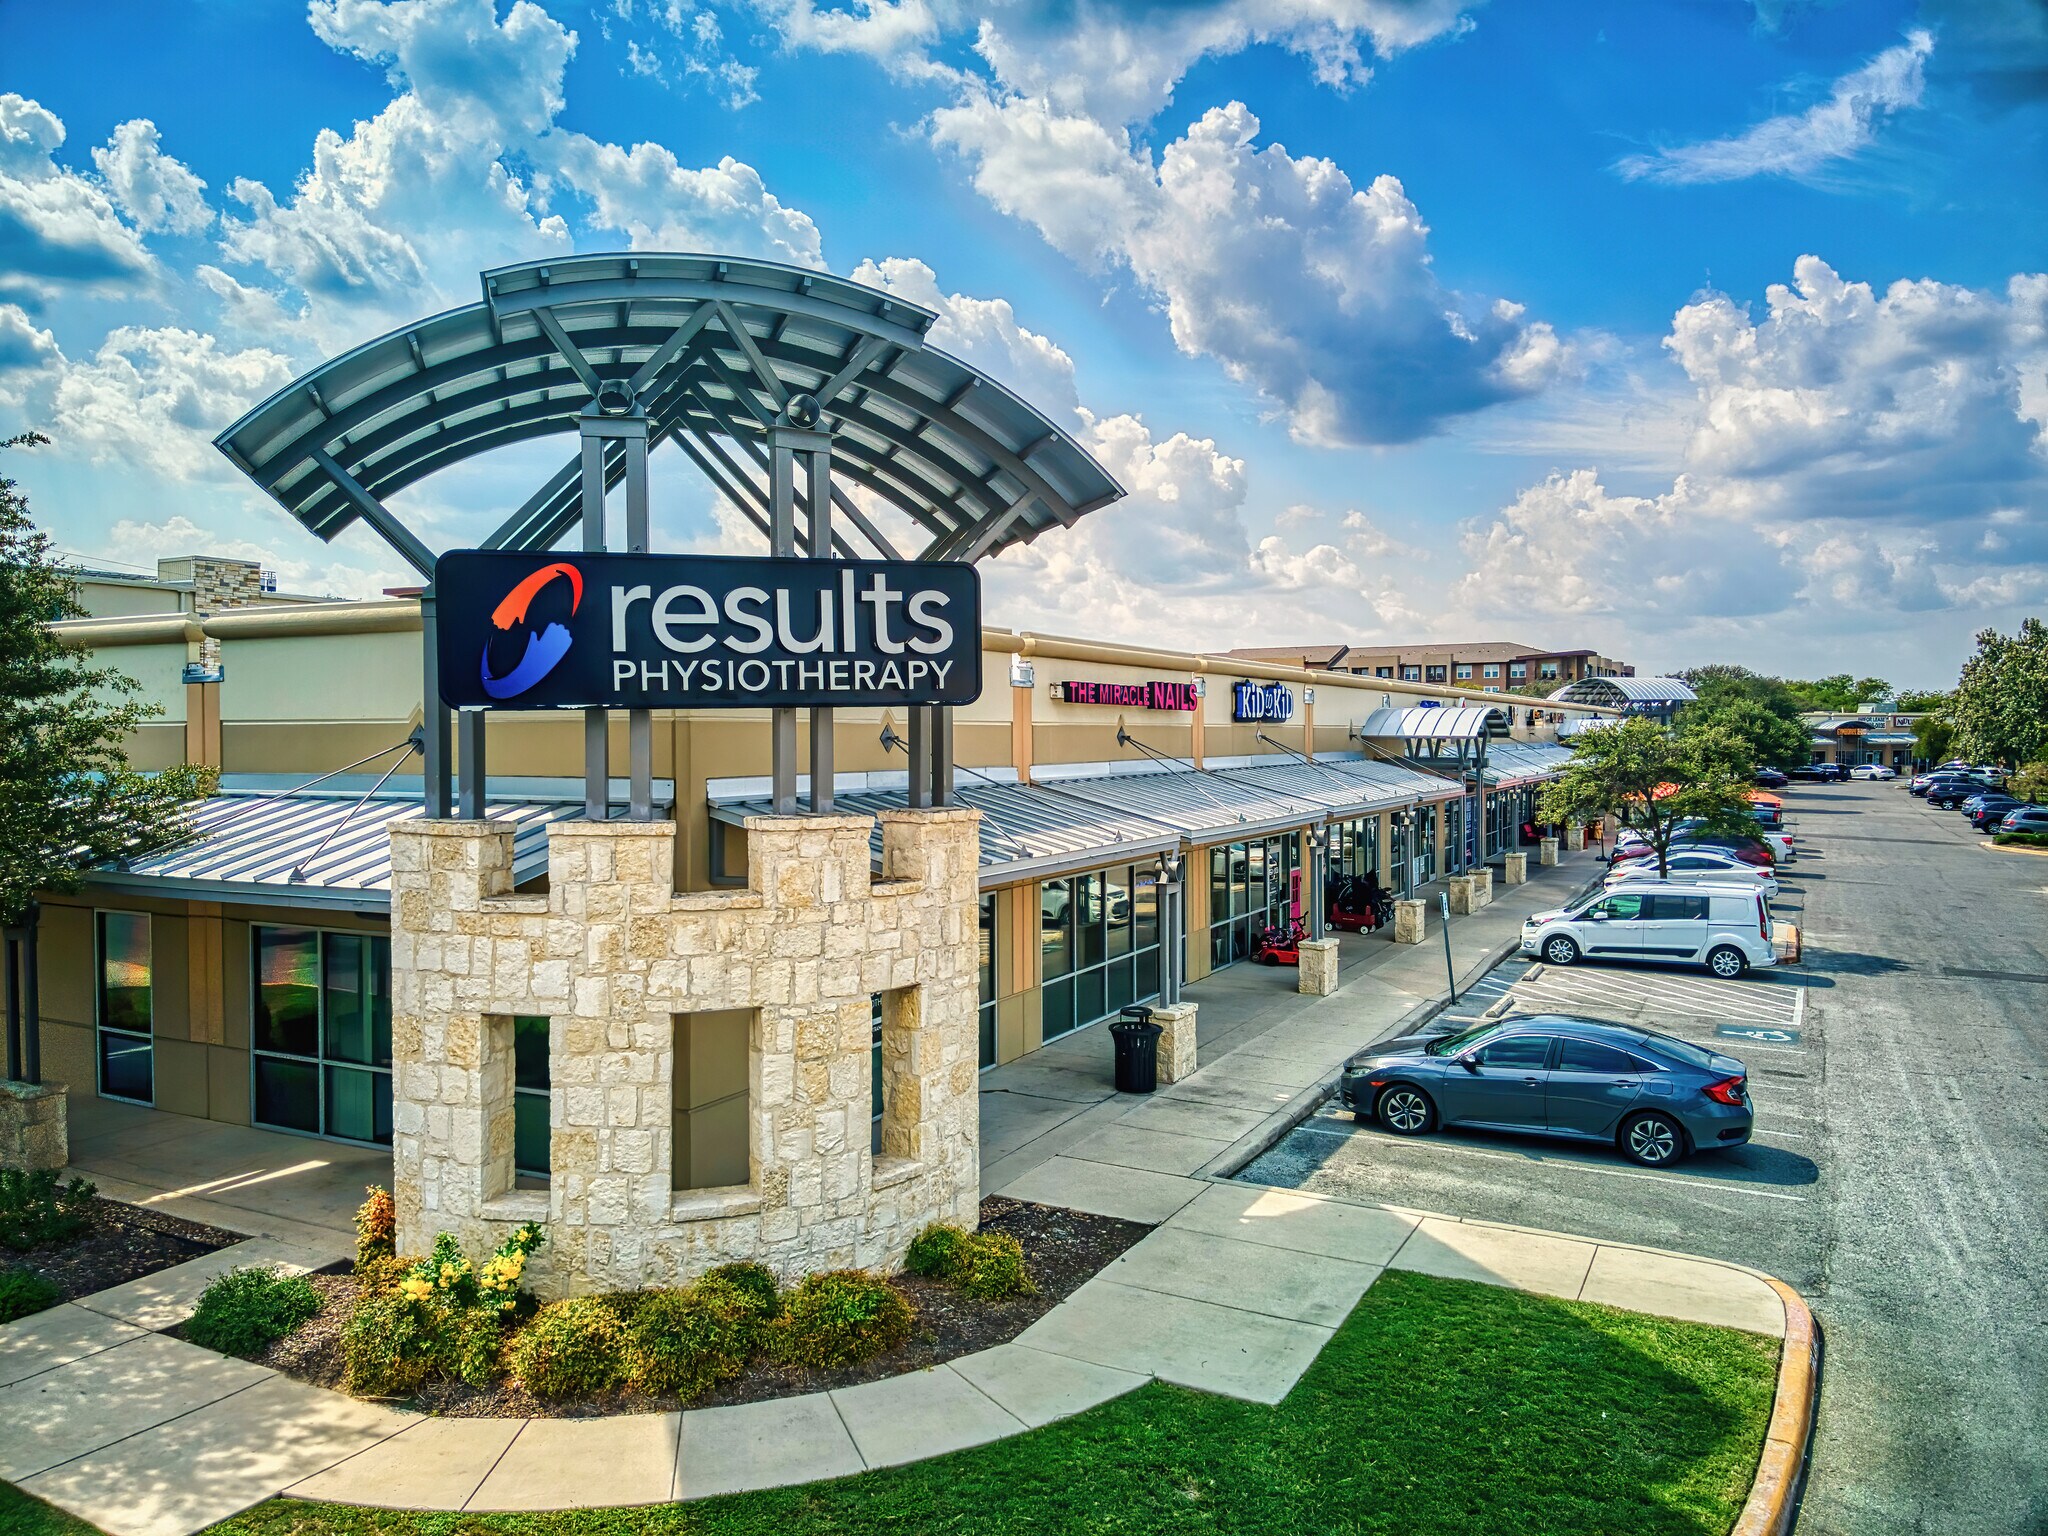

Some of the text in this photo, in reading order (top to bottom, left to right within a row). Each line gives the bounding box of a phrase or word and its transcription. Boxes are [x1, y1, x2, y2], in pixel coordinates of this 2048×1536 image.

[612, 568, 953, 654] results
[612, 659, 953, 691] PHYSIOTHERAPY
[1069, 681, 1198, 711] THE MIRACLE NAILS
